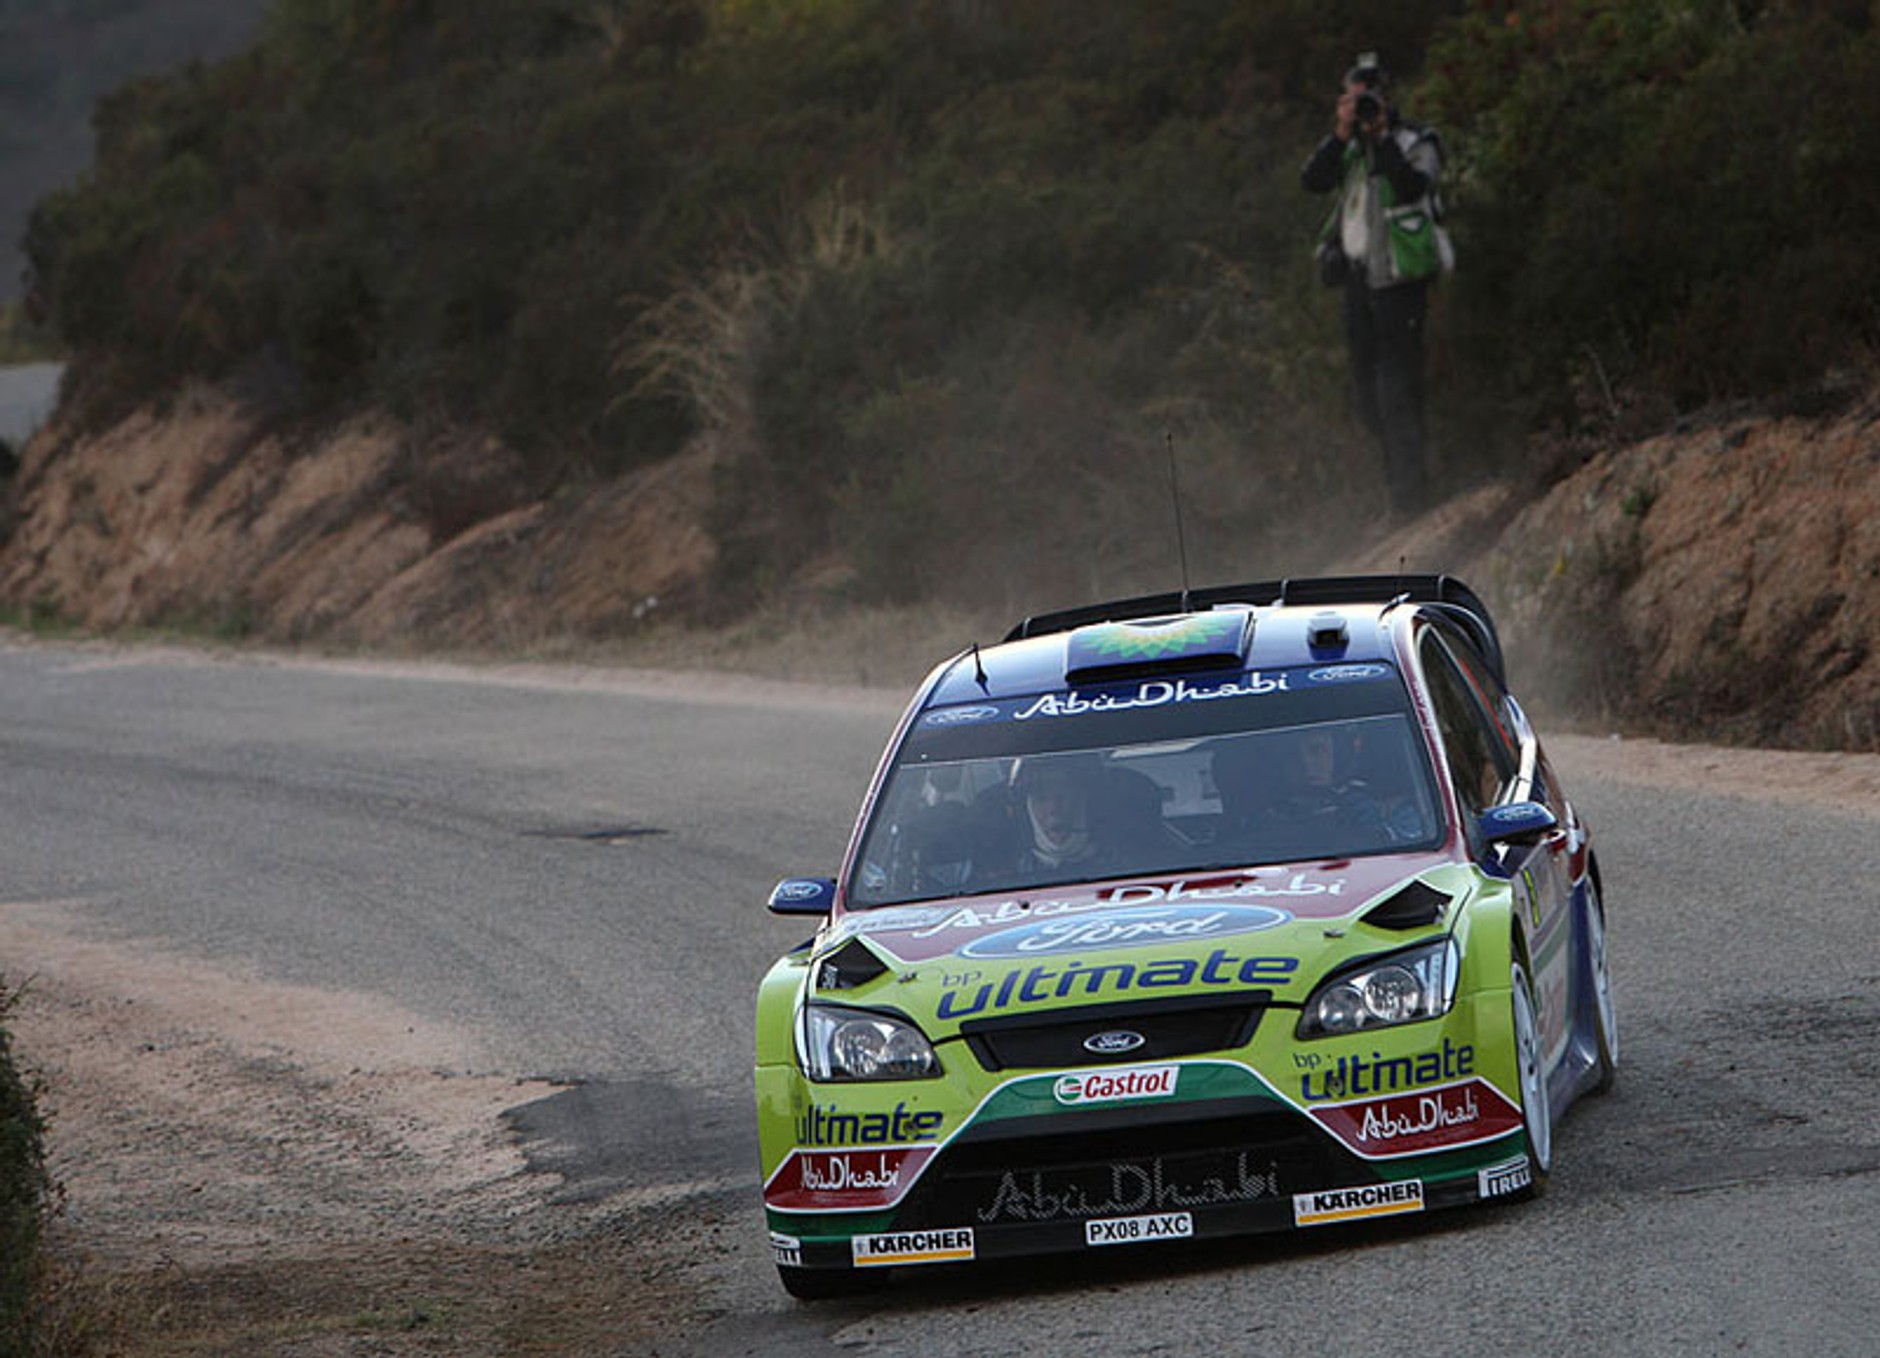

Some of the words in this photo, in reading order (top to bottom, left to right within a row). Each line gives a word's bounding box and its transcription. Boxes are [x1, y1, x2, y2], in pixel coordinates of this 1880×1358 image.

[1135, 672, 1290, 706] Dhabi
[1017, 909, 1229, 951] Ford
[936, 949, 1298, 1020] ultimate
[942, 969, 982, 986] bp
[1293, 1052, 1322, 1070] bp
[1301, 1038, 1474, 1101] ultimate
[1085, 1070, 1170, 1098] Castrol
[795, 1101, 943, 1144] ultimate
[1420, 1087, 1480, 1131] Dhabi
[829, 1153, 900, 1189] Dhabi
[1106, 1152, 1279, 1211] Dhabi
[1090, 1220, 1139, 1241] PX08
[1147, 1215, 1188, 1236] AXC
